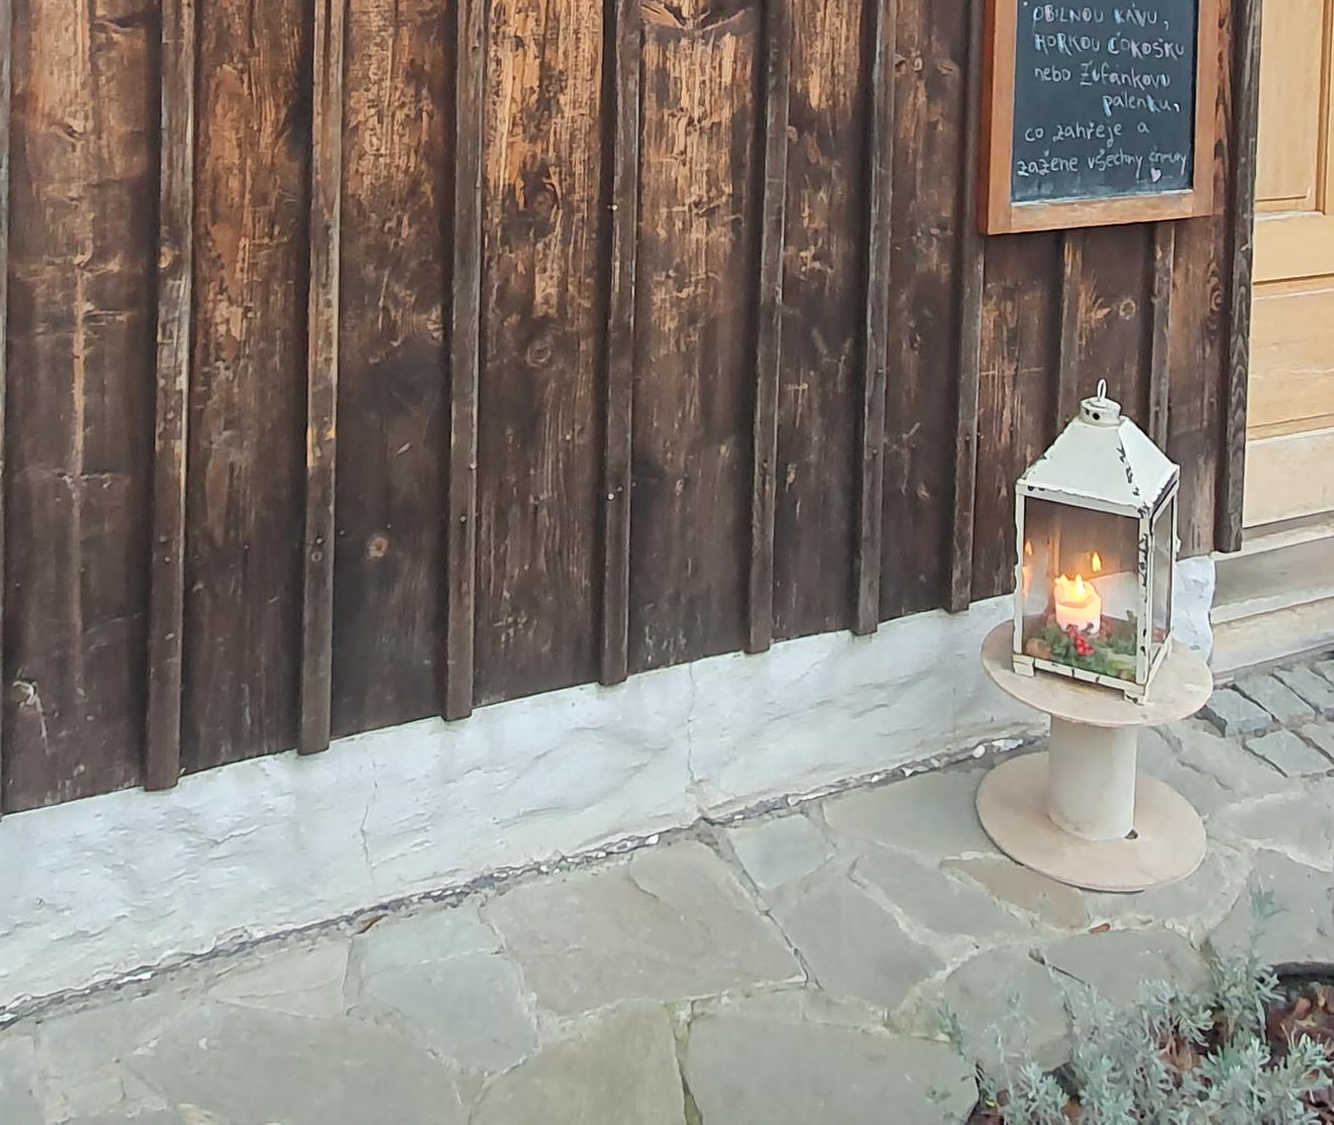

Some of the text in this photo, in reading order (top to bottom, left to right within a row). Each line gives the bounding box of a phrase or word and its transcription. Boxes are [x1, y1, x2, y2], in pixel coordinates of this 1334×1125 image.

[1032, 4, 1104, 24] OBILNOU
[1034, 32, 1100, 56] HORKOU
[1034, 62, 1072, 83] nebo
[1024, 120, 1151, 148] co zahřeje a
[1017, 149, 1079, 177] zažene
[1087, 146, 1144, 179] všechny
